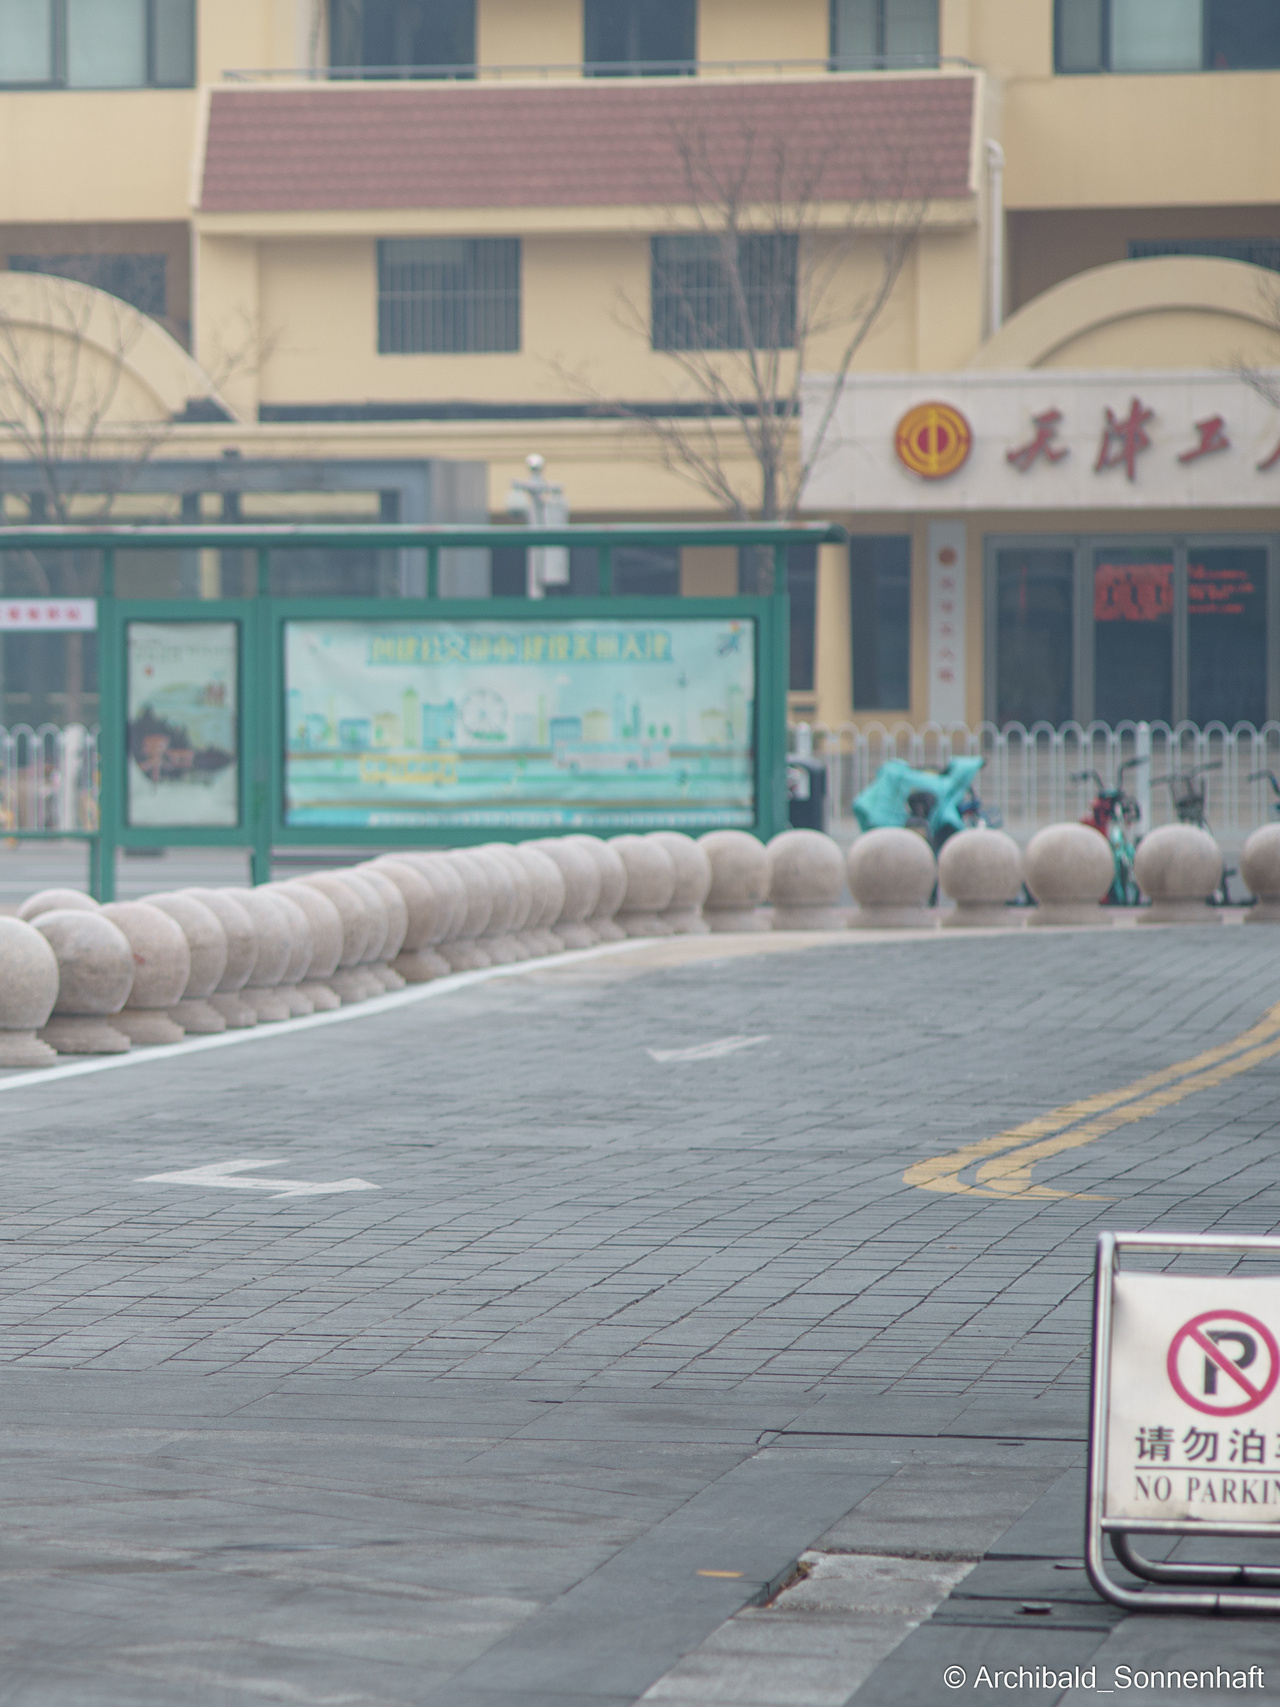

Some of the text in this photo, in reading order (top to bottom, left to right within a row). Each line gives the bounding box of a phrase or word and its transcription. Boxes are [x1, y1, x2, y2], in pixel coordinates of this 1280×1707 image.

[1006, 398, 1280, 482] 天津工
[1134, 1425, 1280, 1465] 请勿泊
[1134, 1475, 1173, 1502] NO
